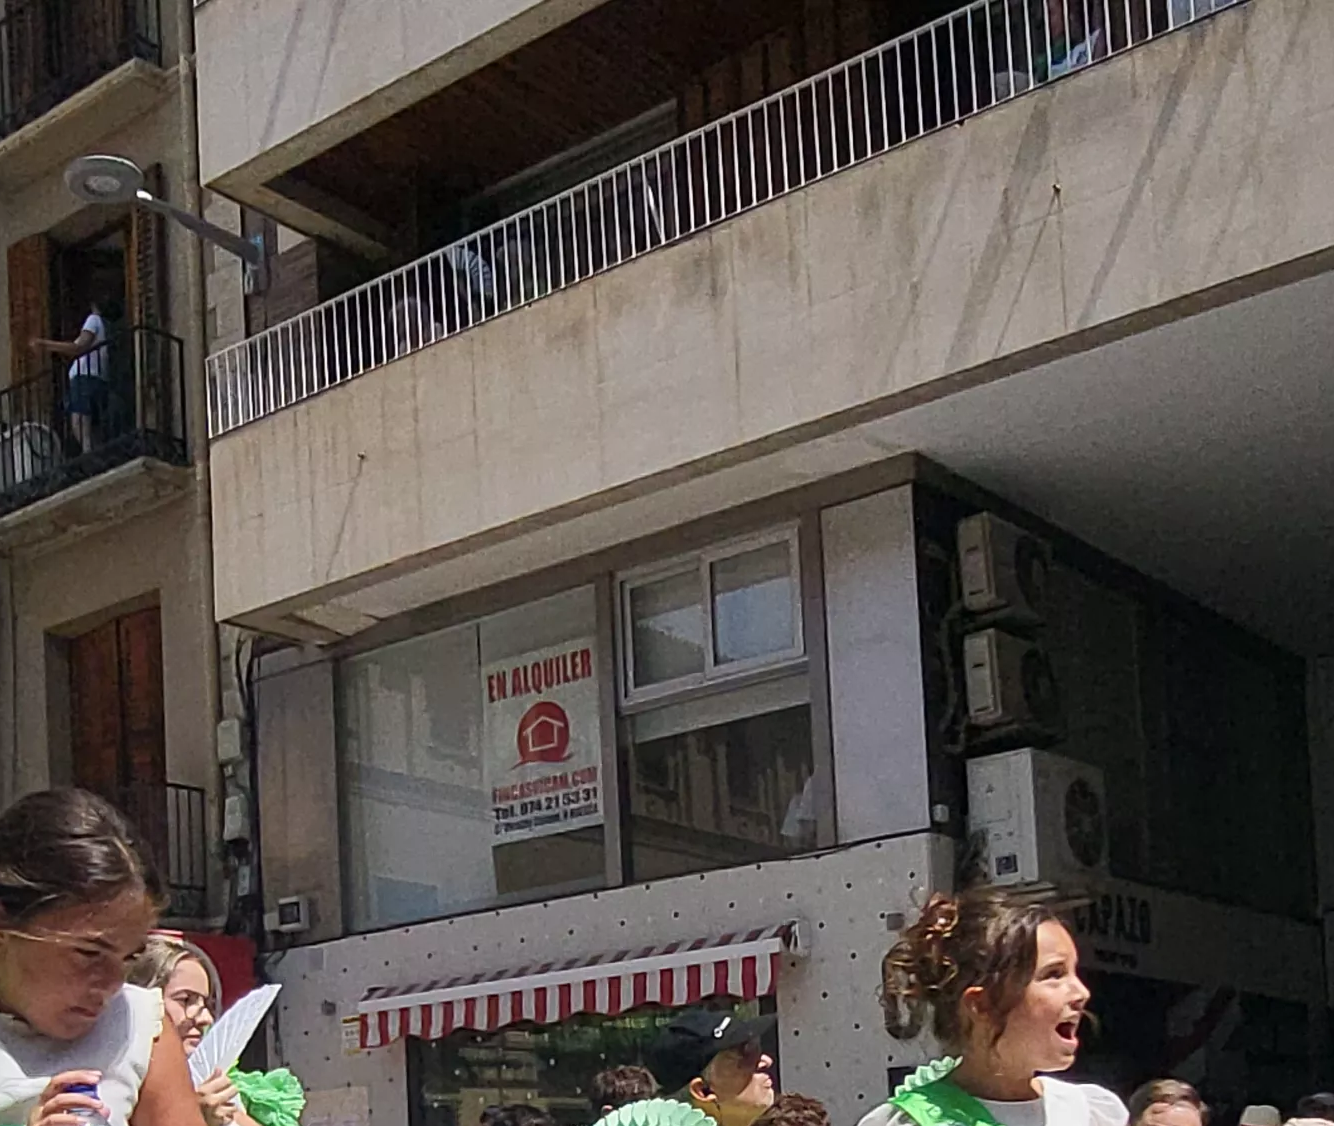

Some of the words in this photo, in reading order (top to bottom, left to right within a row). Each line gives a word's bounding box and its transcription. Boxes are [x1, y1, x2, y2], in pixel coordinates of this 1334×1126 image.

[487, 671, 507, 703] EN
[511, 648, 592, 697] ALQUILER
[545, 794, 560, 811] 21
[583, 786, 598, 801] 31
